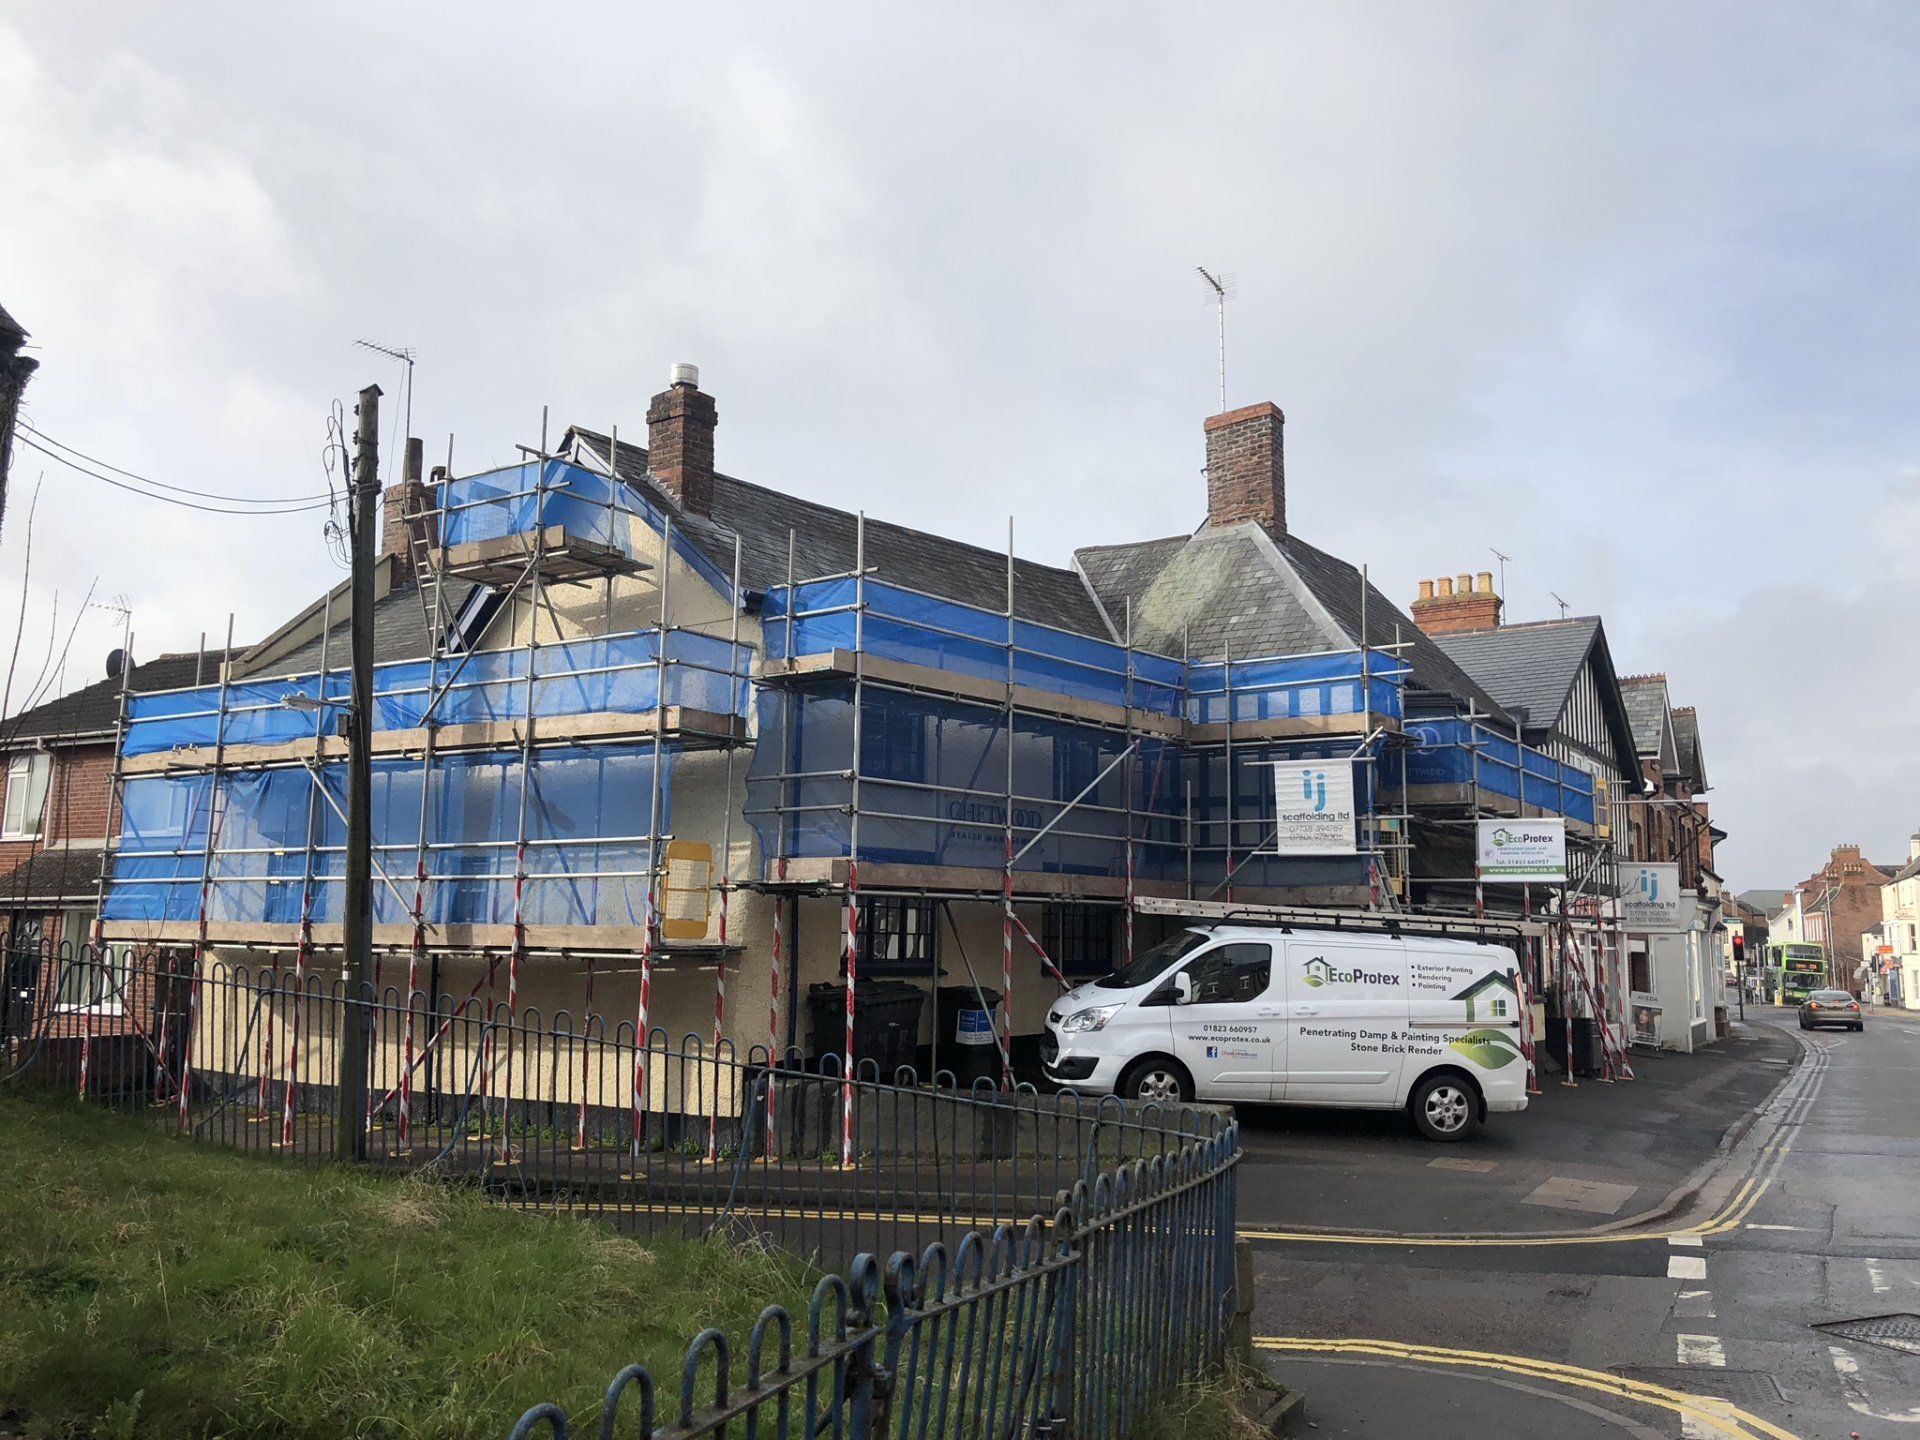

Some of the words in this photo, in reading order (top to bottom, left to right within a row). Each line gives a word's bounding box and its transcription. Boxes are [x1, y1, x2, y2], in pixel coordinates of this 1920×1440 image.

[1302, 769, 1326, 812] ij
[1282, 812, 1335, 821] scaffolding
[1337, 811, 1350, 820] ltd
[1508, 834, 1554, 843] EcoProtex
[1488, 866, 1558, 874] www.ecoprotex.co.uk
[1641, 869, 1658, 901] ij
[1624, 901, 1665, 909] scaffolding
[1417, 964, 1444, 972] Exterior
[1446, 965, 1473, 975] Painting
[1329, 967, 1401, 986] EcoProtex
[1418, 973, 1452, 983] Rendering
[1418, 982, 1446, 992] Pointing
[1203, 1024, 1227, 1032] 01823
[1229, 1025, 1258, 1034] 660957
[1188, 1034, 1272, 1044] www.ecoprotex.co.uk
[1299, 1026, 1357, 1041] Penetrating
[1359, 1029, 1388, 1041] Damp
[1390, 1031, 1399, 1041] &
[1401, 1031, 1440, 1045] Painting
[1443, 1033, 1491, 1046] Specialists
[1350, 1042, 1379, 1053] Stone
[1381, 1044, 1405, 1054] Brick
[1408, 1045, 1443, 1056] Render
